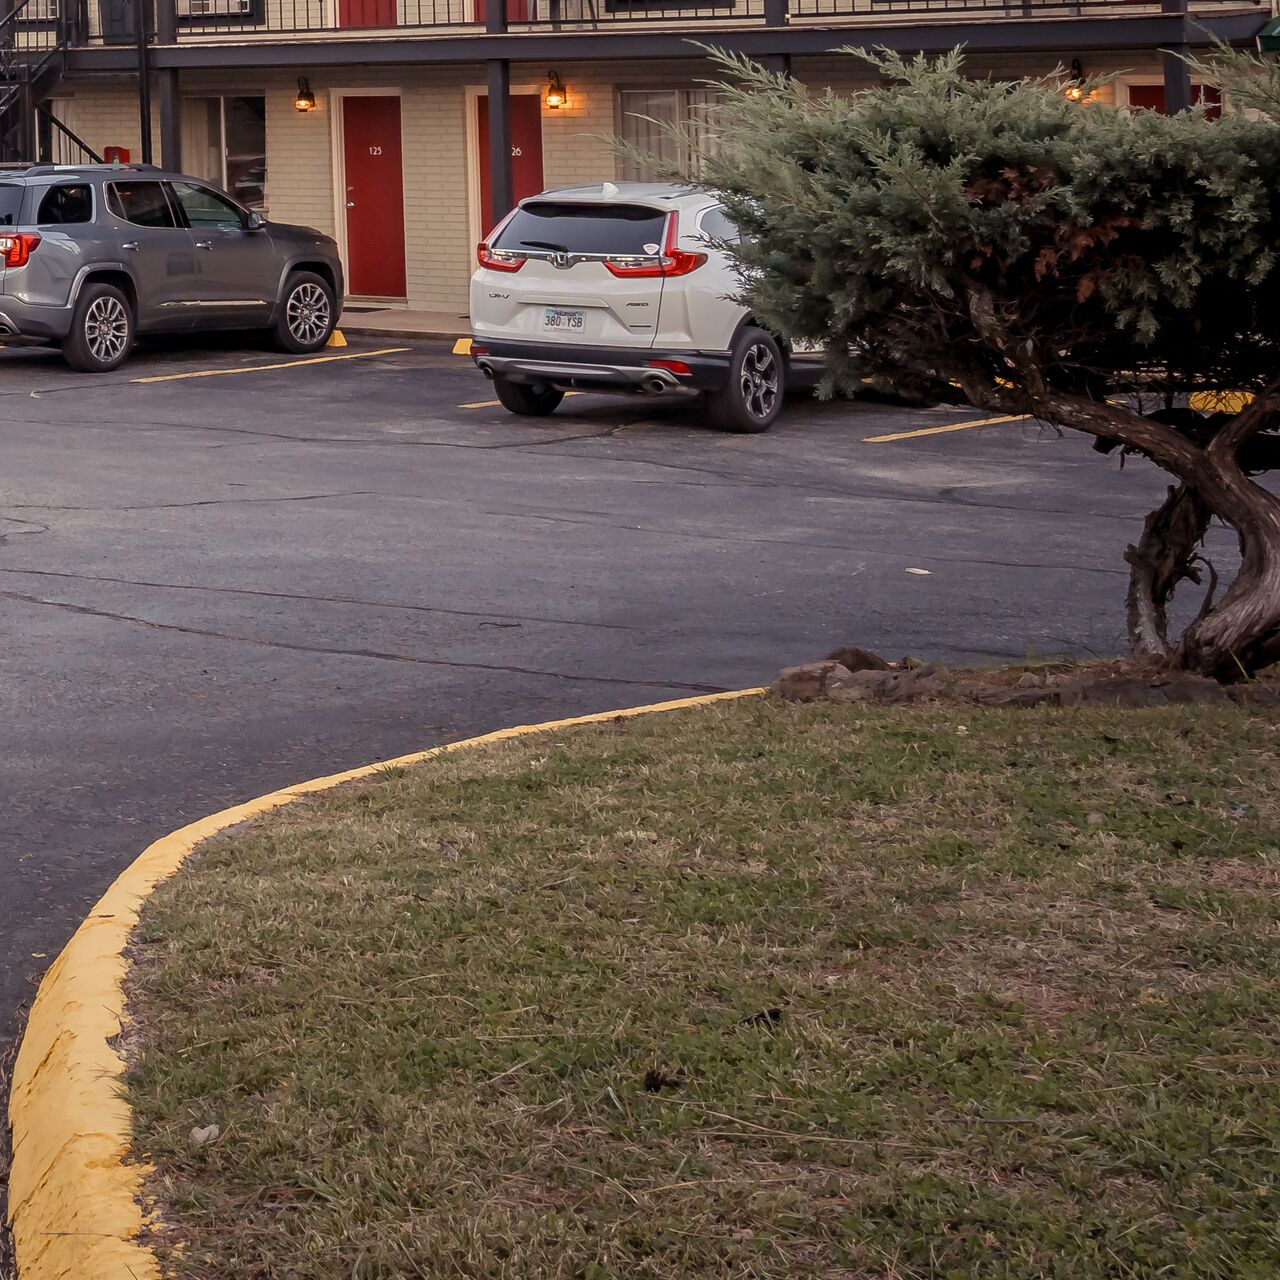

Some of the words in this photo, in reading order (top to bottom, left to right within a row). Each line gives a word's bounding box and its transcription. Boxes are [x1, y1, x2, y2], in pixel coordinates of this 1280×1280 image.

[369, 146, 382, 156] 125
[544, 315, 561, 327] 380
[567, 317, 583, 328] YSB
